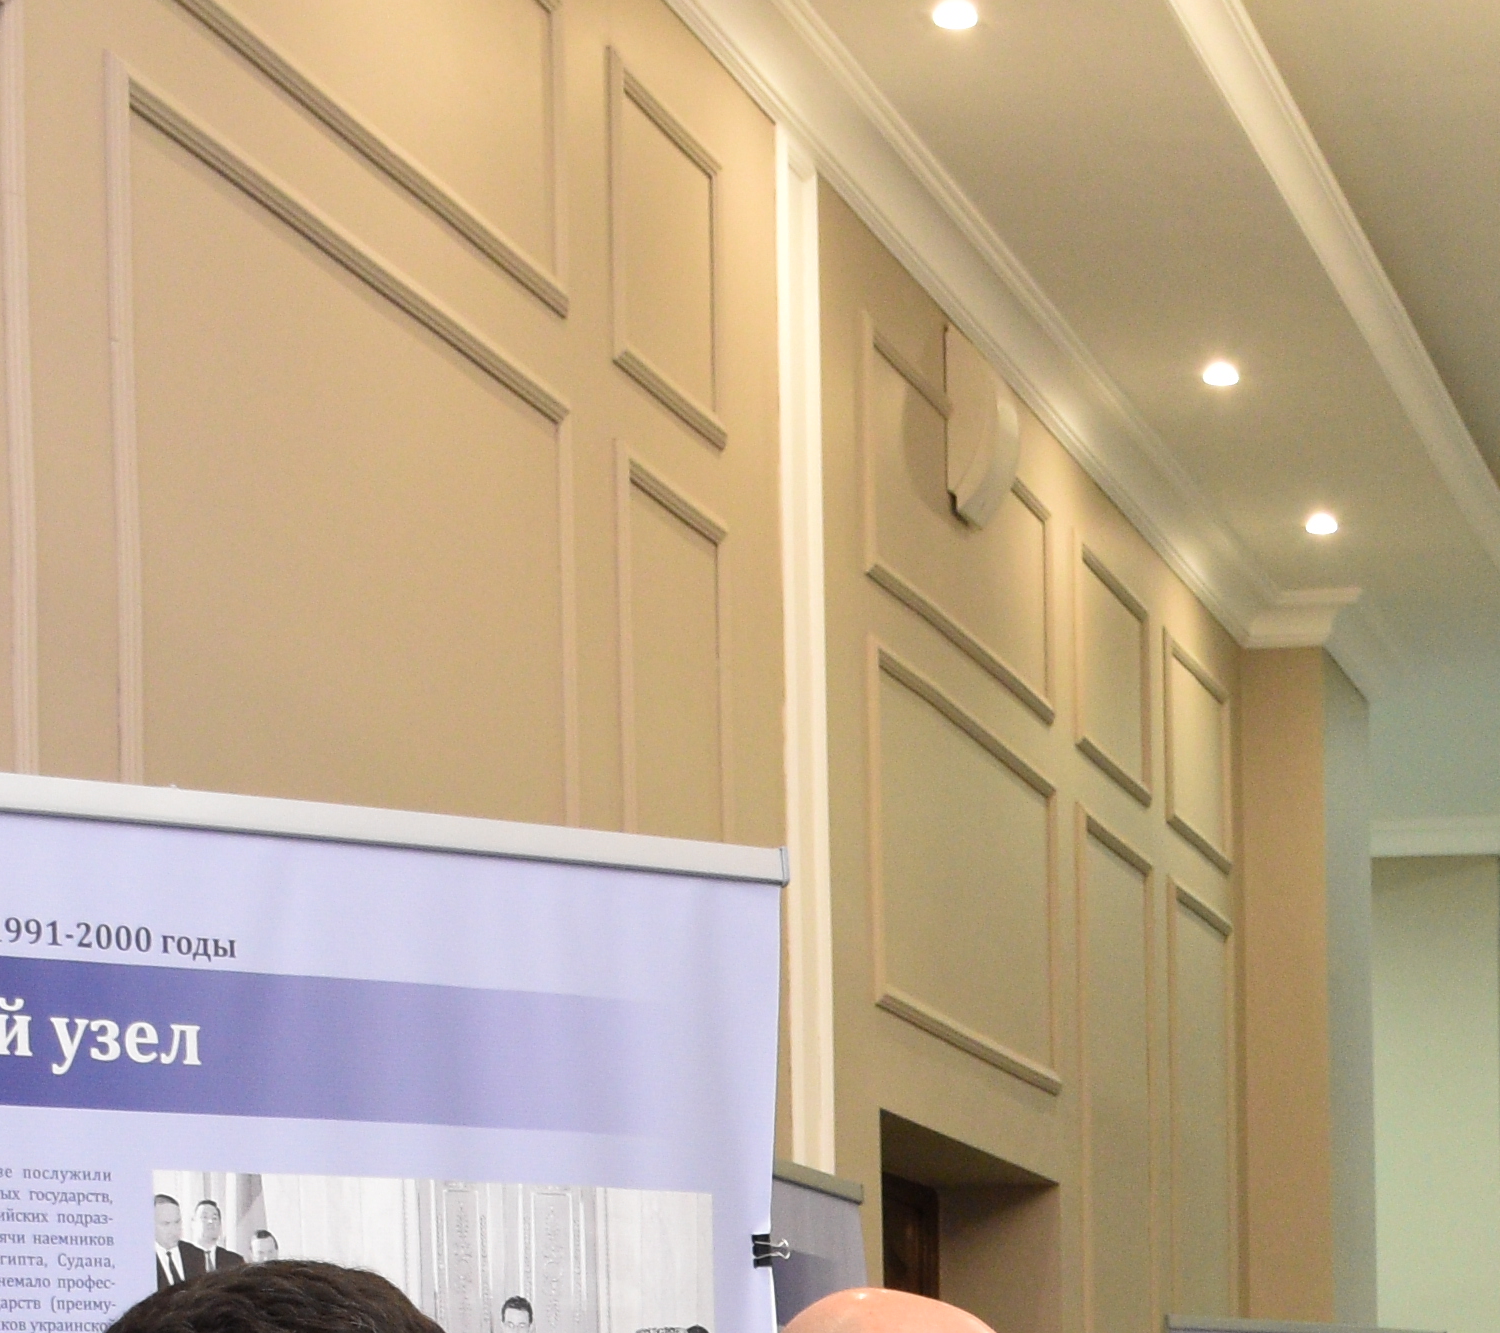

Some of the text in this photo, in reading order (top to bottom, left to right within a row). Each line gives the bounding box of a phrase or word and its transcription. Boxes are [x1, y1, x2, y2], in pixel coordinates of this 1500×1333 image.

[161, 933, 236, 963] годы
[49, 1016, 202, 1076] узел
[22, 1167, 112, 1186] послужили
[28, 1189, 113, 1208] государств,
